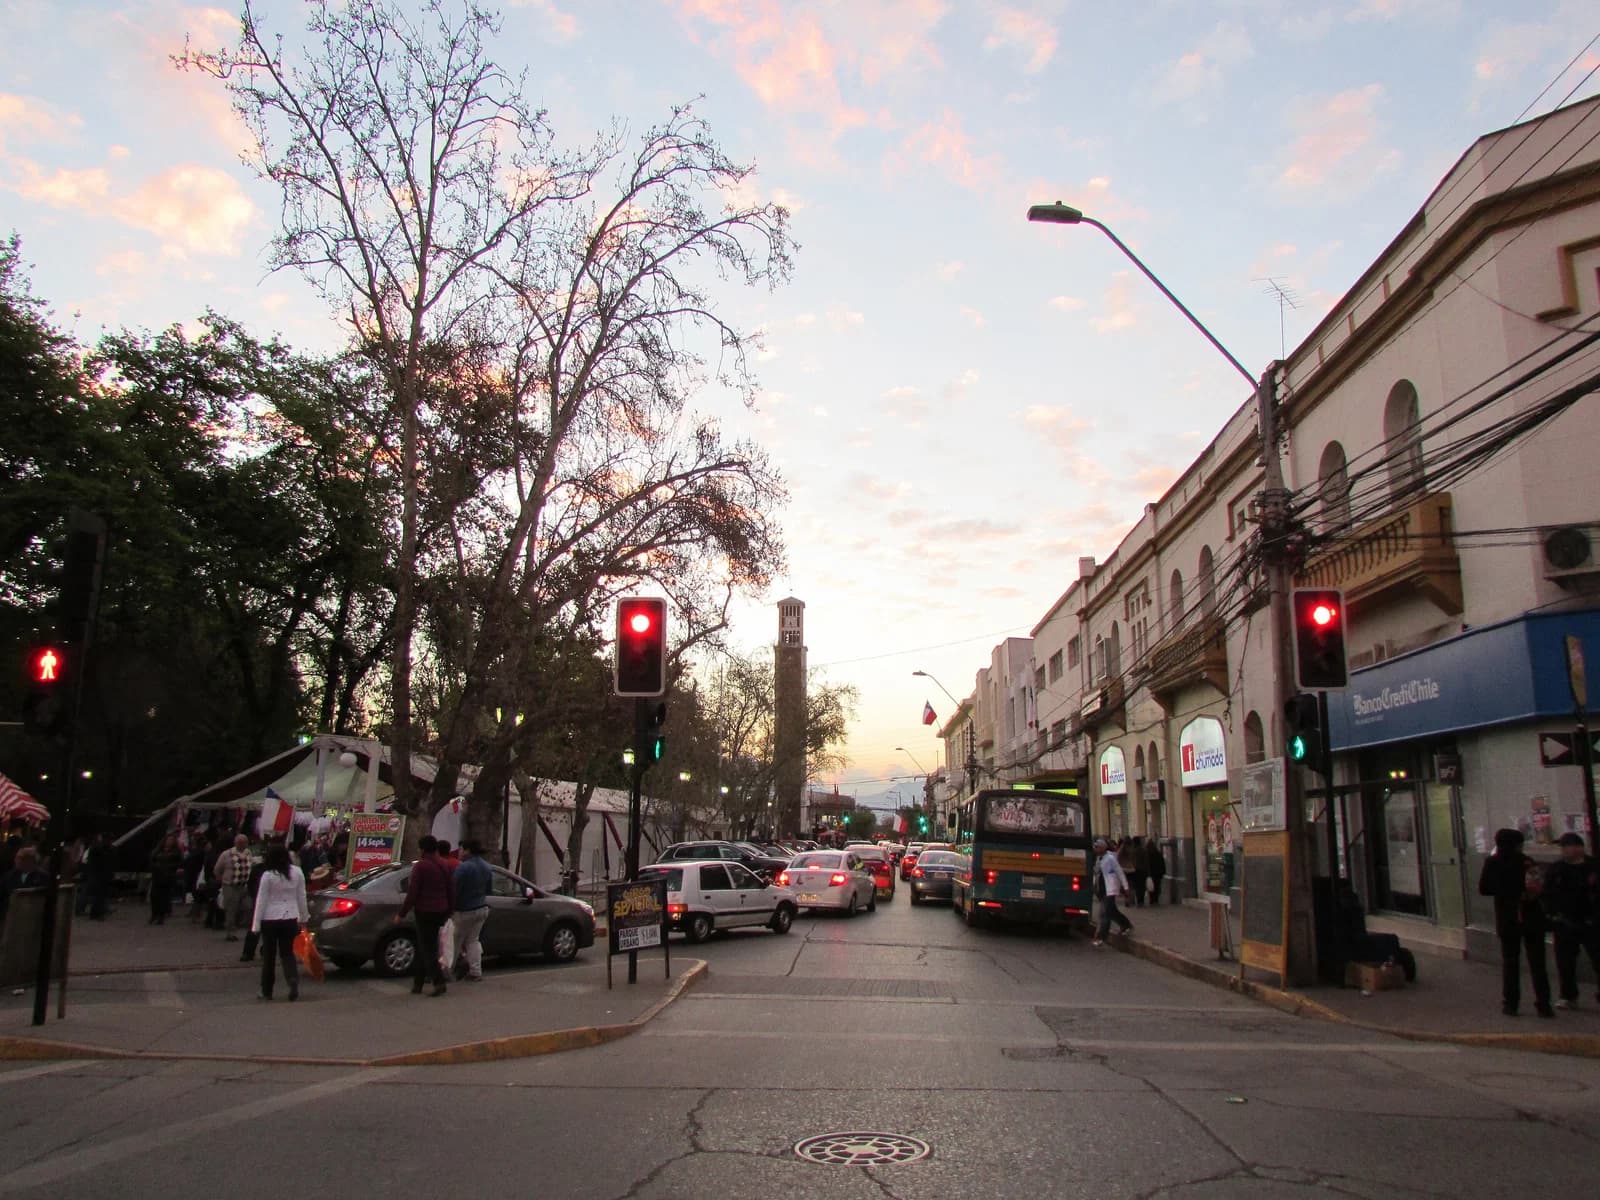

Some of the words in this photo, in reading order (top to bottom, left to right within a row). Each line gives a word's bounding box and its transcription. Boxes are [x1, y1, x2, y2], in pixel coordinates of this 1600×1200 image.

[1353, 677, 1440, 715] BancoCrediChile
[619, 927, 639, 938] PARQUE
[619, 937, 640, 949] URBANO
